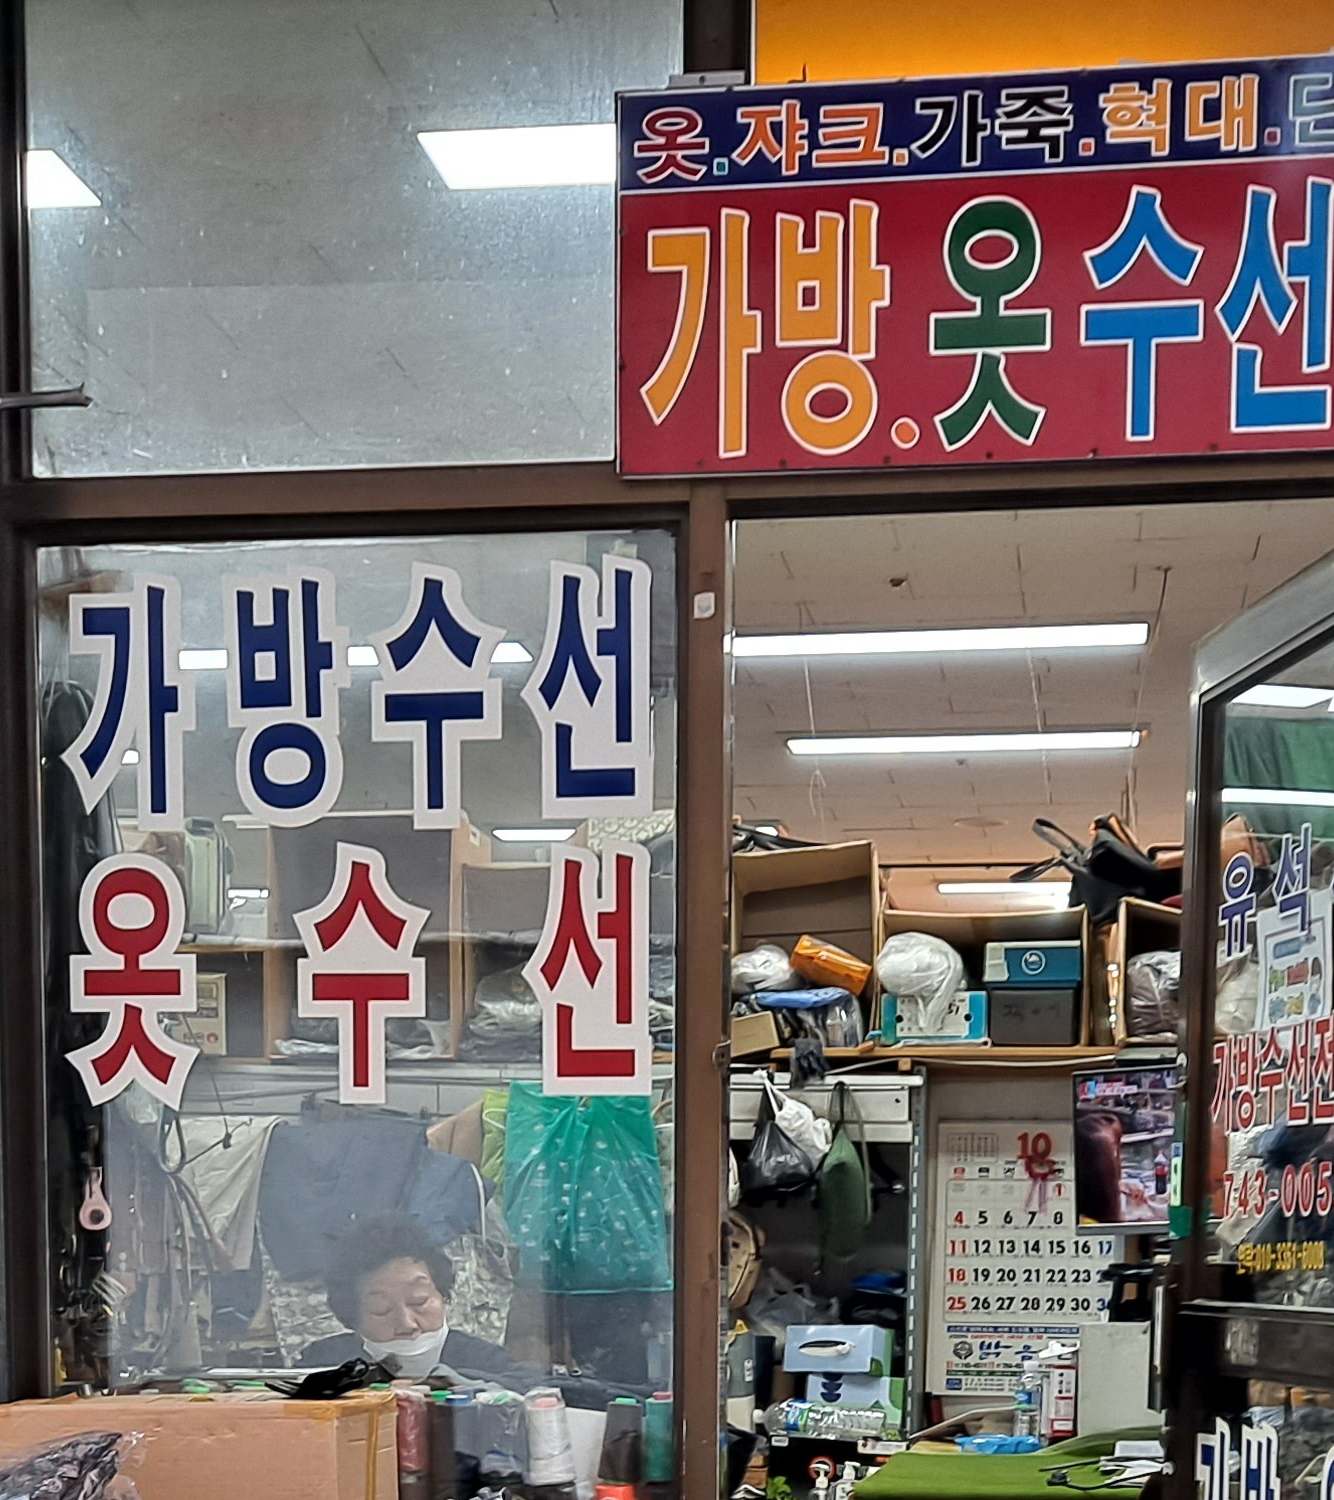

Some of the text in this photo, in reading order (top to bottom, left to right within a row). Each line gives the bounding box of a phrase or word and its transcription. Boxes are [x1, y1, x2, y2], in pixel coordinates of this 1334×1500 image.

[70, 558, 647, 826] 가방수선
[72, 858, 192, 1100] 옷
[953, 1210, 1063, 1226] 4 5 6 7 8
[949, 1239, 1112, 1255] 11 12 13 14 15 16 17
[948, 1268, 966, 1282] 18
[973, 1268, 991, 1282] 19
[996, 1268, 1016, 1282] 20
[1022, 1269, 1041, 1282] 21
[1046, 1269, 1067, 1282] 22
[1071, 1269, 1091, 1283] 23
[947, 1296, 966, 1311] 25
[971, 1297, 991, 1310] 26
[996, 1297, 1016, 1311] 27
[1021, 1297, 1040, 1311] 28
[1045, 1298, 1066, 1312] 29
[1071, 1298, 1090, 1311] 30
